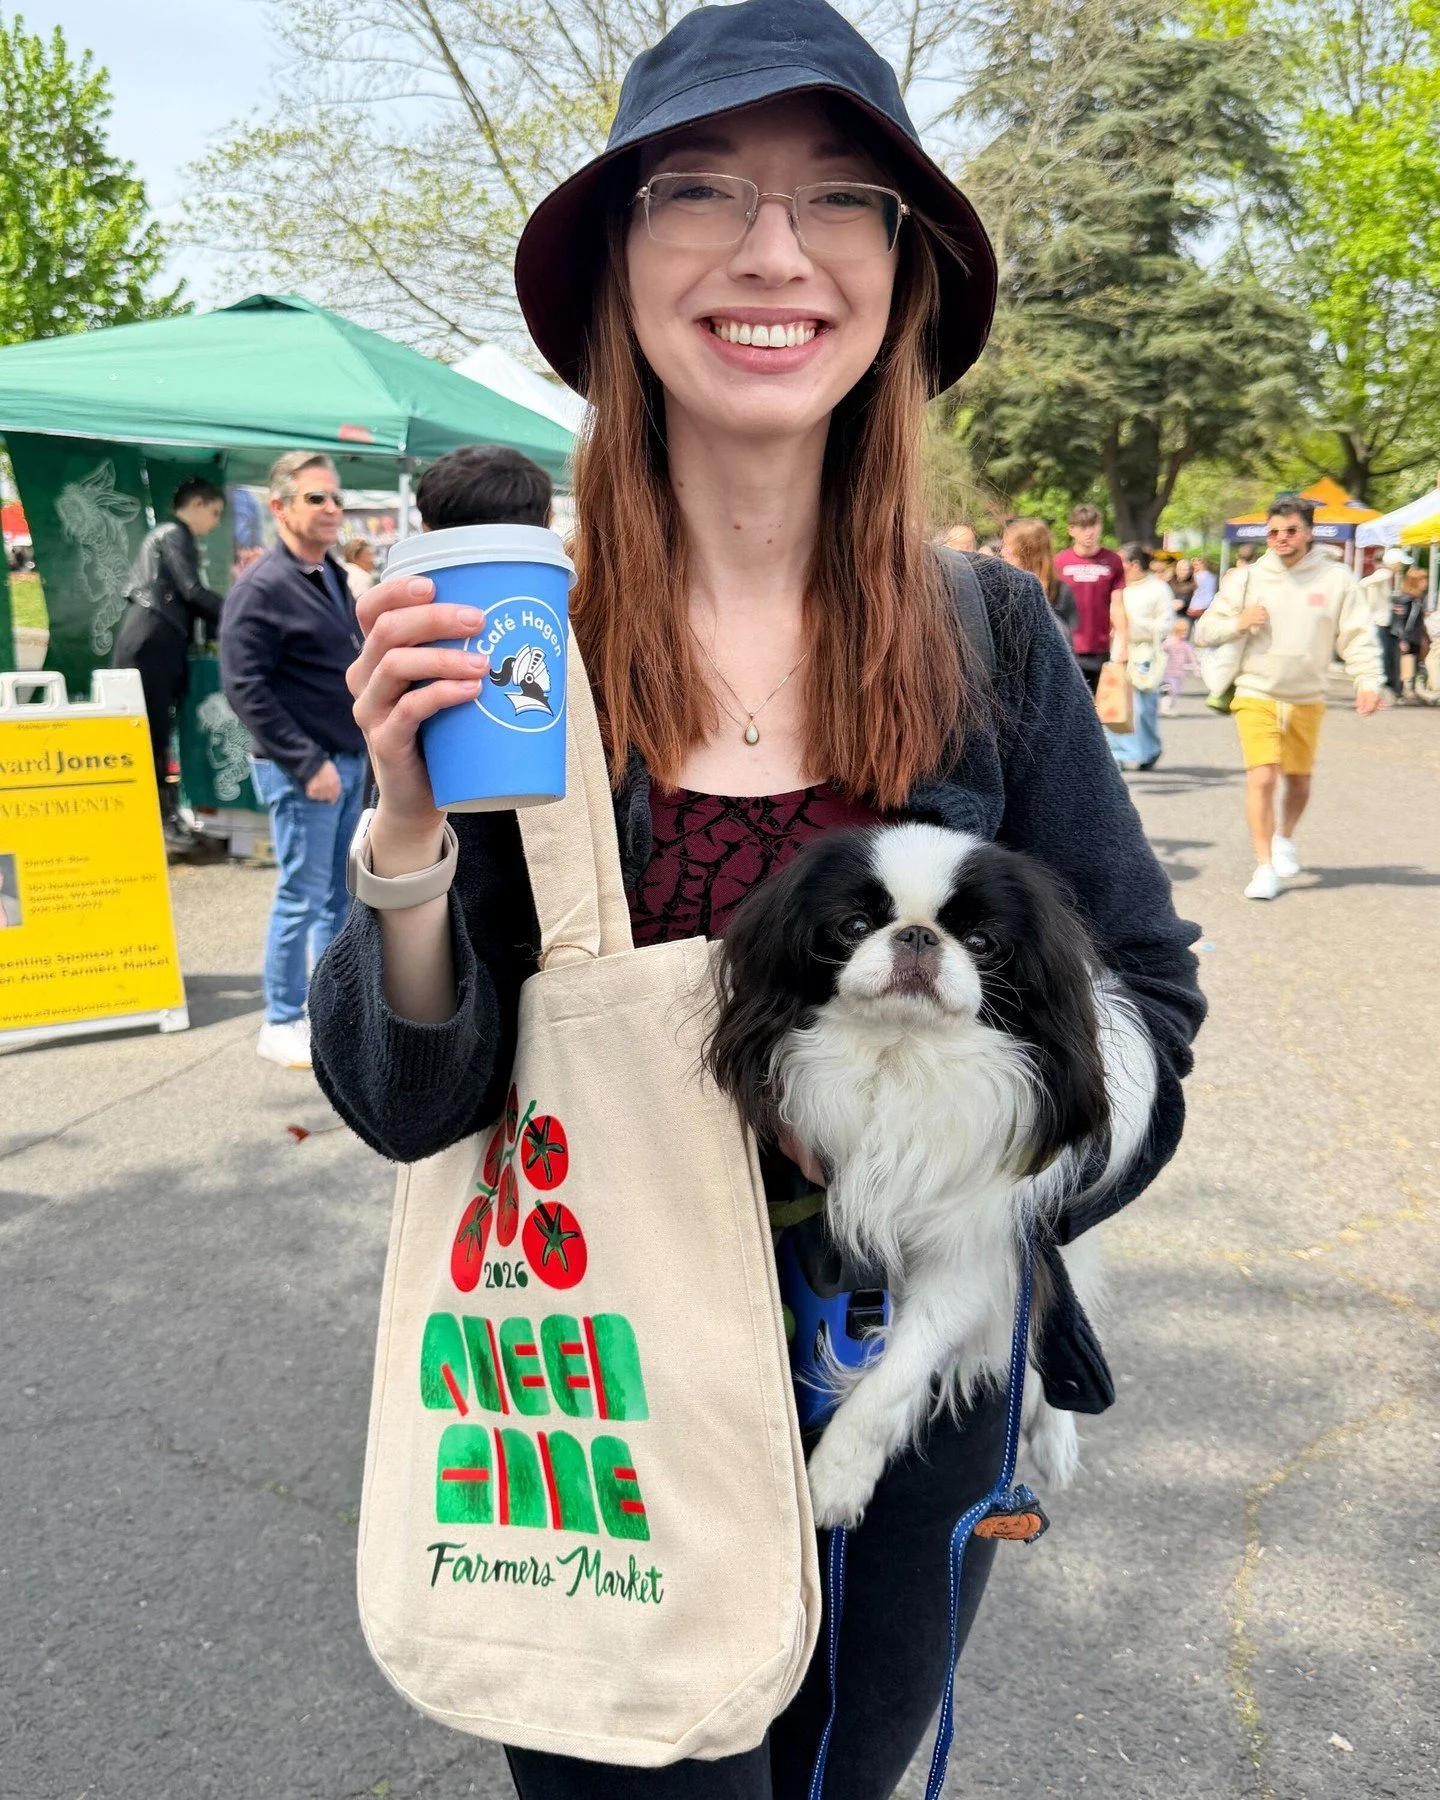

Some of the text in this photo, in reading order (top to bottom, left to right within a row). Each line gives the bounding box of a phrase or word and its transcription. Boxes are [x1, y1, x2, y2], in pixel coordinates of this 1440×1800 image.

[476, 610, 562, 657] Café Hagen
[56, 750, 134, 774] Jones
[484, 1261, 528, 1289] 2026
[420, 1311, 650, 1422] QUEEN
[435, 1423, 651, 1542] ANNE
[426, 1541, 664, 1604] Farmers Market
